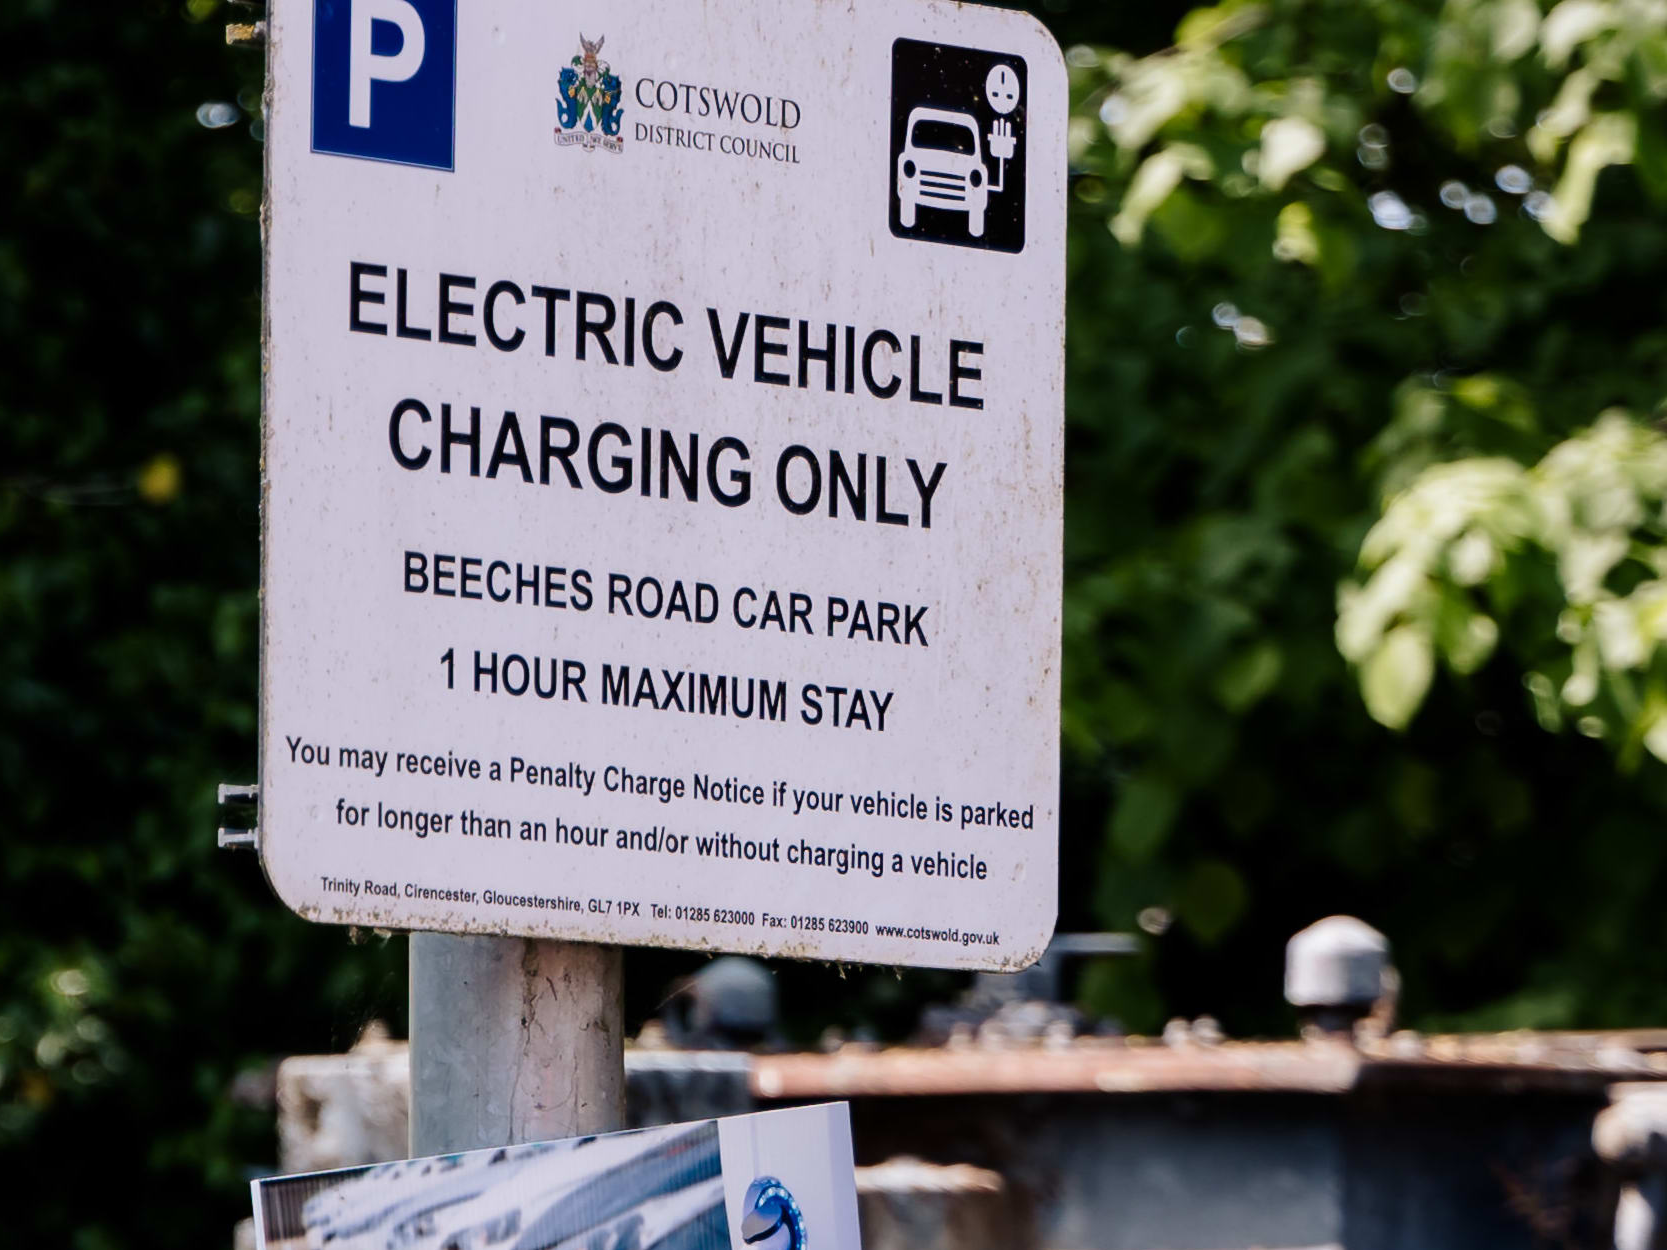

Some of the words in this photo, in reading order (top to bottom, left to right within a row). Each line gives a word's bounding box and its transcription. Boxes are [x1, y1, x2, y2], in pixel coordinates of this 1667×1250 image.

[349, 0, 425, 128] P
[636, 78, 800, 128] COTSWOLD
[636, 123, 715, 151] DISTRICT
[720, 136, 799, 163] COUNCIL
[350, 262, 683, 372] ELECTRIC
[707, 308, 983, 410] VEHICLE
[389, 399, 751, 507] CHARGING
[776, 445, 947, 528] ONLY
[405, 551, 593, 611] BEECHES
[609, 573, 718, 623] ROAD
[733, 587, 813, 634] CAR
[828, 597, 928, 647] PARK
[441, 648, 454, 689] 1
[474, 651, 587, 702] HOUR
[602, 664, 786, 721] MAXIMUM
[801, 684, 894, 731] STAY
[286, 736, 329, 765] You
[340, 748, 388, 777] may
[397, 751, 480, 779] receive
[489, 762, 501, 781] a
[511, 757, 595, 796] Penalty
[604, 766, 684, 803] Charge
[694, 774, 764, 805] Notice
[773, 781, 787, 807] if
[793, 790, 843, 815] your
[850, 791, 927, 820] vehicle
[936, 796, 952, 822] is
[961, 802, 1033, 830] parked
[336, 798, 369, 826] for
[378, 802, 453, 838] longer
[461, 810, 511, 838] than
[520, 821, 546, 842] an
[556, 818, 608, 847] hour
[616, 826, 689, 854] and/or
[696, 832, 779, 862] without
[788, 839, 883, 877] charging
[892, 854, 903, 872] a
[911, 851, 987, 880] vehicle
[321, 877, 360, 897] Trinity
[365, 880, 400, 898] Road,
[405, 884, 478, 905] Cirencester,
[483, 890, 584, 914] Gloucestershire,
[588, 899, 612, 914] GL7
[617, 901, 639, 916] 1PX
[651, 904, 671, 919] Tel:
[676, 906, 710, 921] 01285
[714, 909, 755, 925] 623000
[762, 913, 787, 928] Fax:
[791, 915, 824, 931] 01285
[829, 918, 868, 934] 623900
[875, 926, 999, 946] www.cotswold.gov.uk
